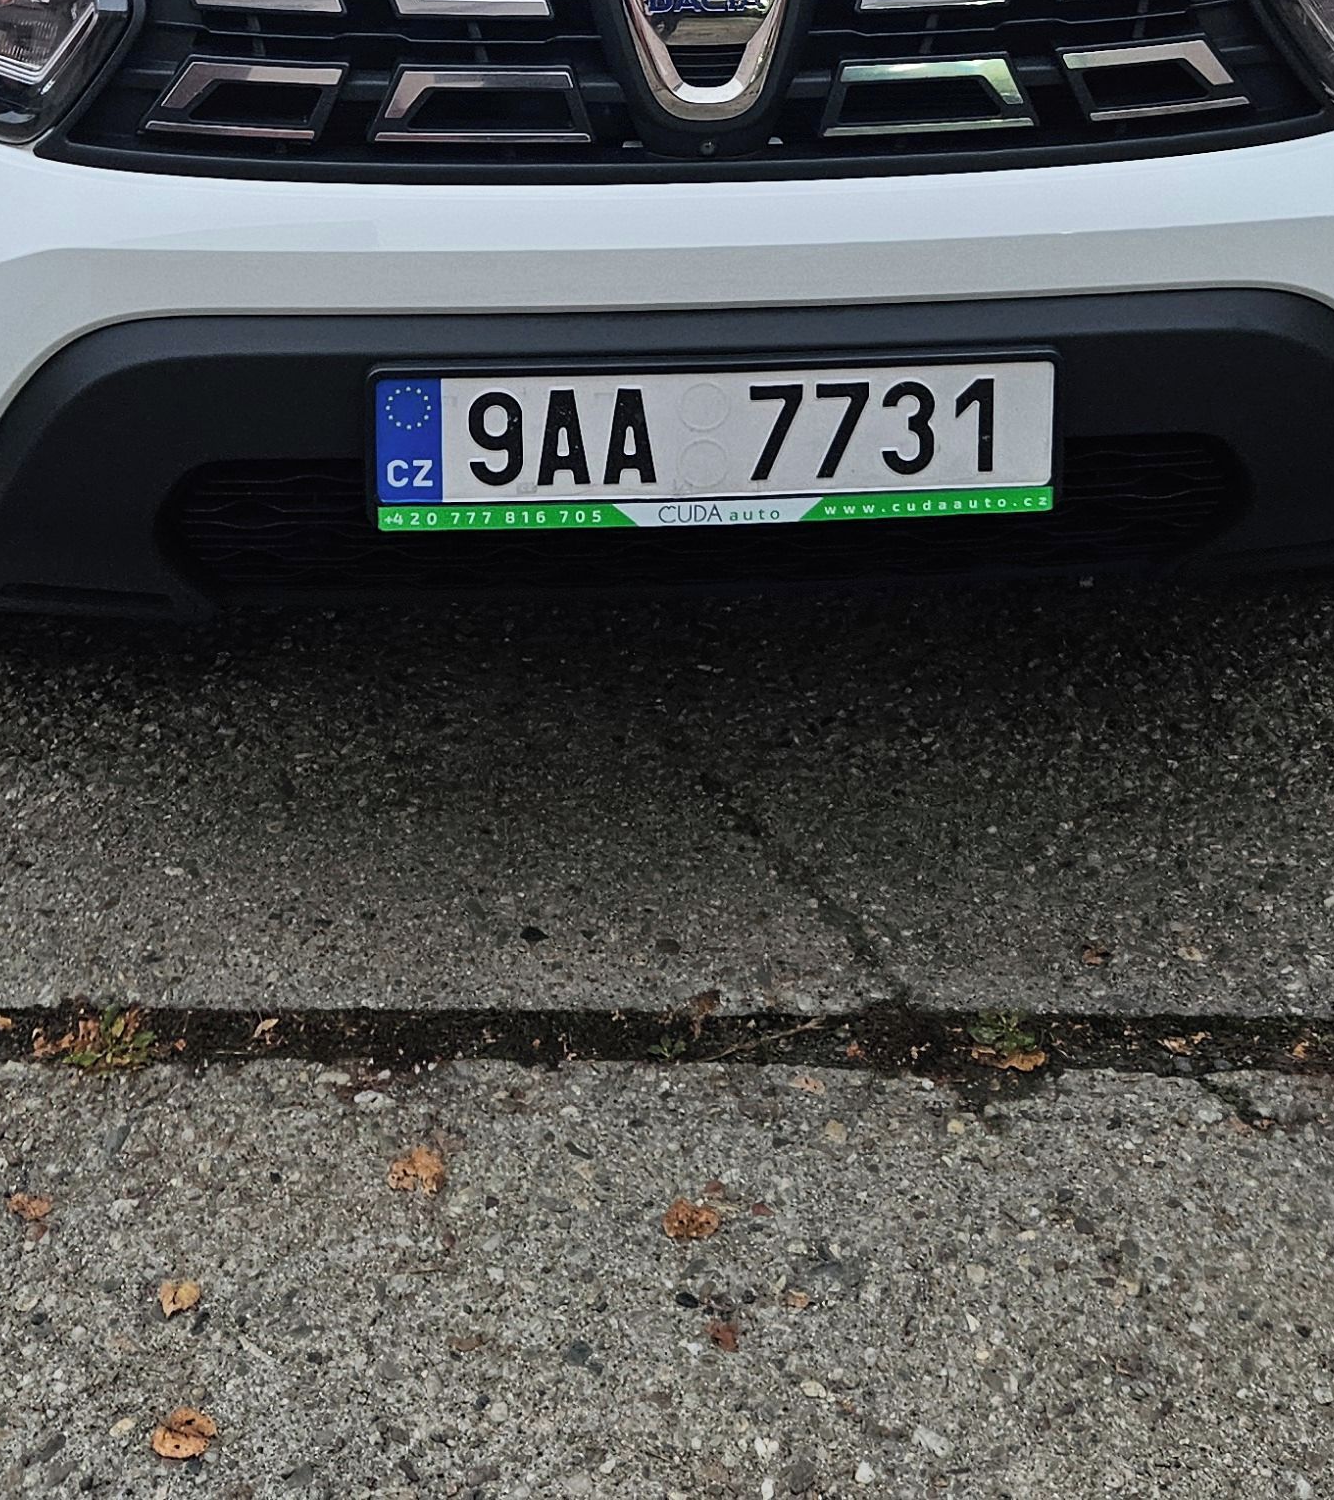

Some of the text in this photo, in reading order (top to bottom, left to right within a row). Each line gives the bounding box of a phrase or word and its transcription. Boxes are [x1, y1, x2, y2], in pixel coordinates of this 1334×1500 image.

[386, 377, 994, 487] CZ 9AA 7731
[729, 508, 781, 522] auto
[823, 495, 1048, 516] www.cudaauto.cz
[384, 509, 602, 526] +420 777 816 705
